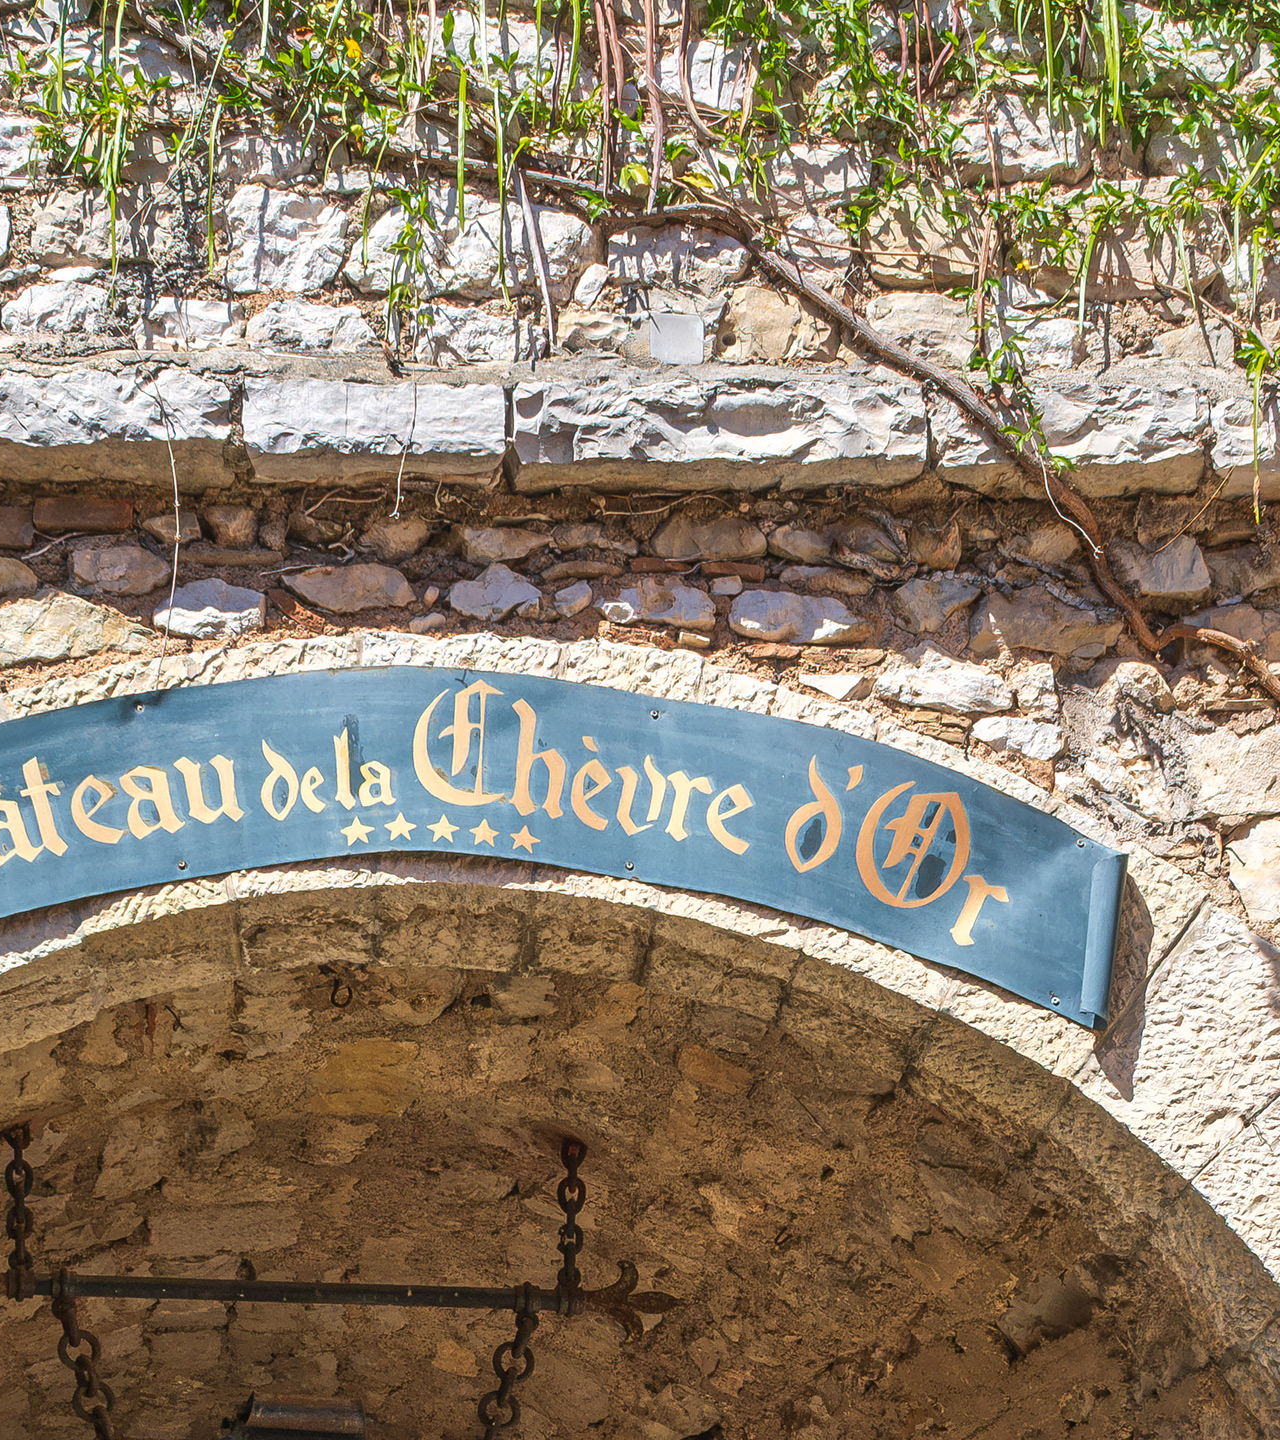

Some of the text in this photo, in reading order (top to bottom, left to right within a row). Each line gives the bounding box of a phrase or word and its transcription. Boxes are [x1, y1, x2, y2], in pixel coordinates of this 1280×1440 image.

[260, 738, 327, 822] de
[332, 726, 398, 811] la
[412, 678, 754, 855] Chèvre
[784, 754, 1012, 947] d'Or
